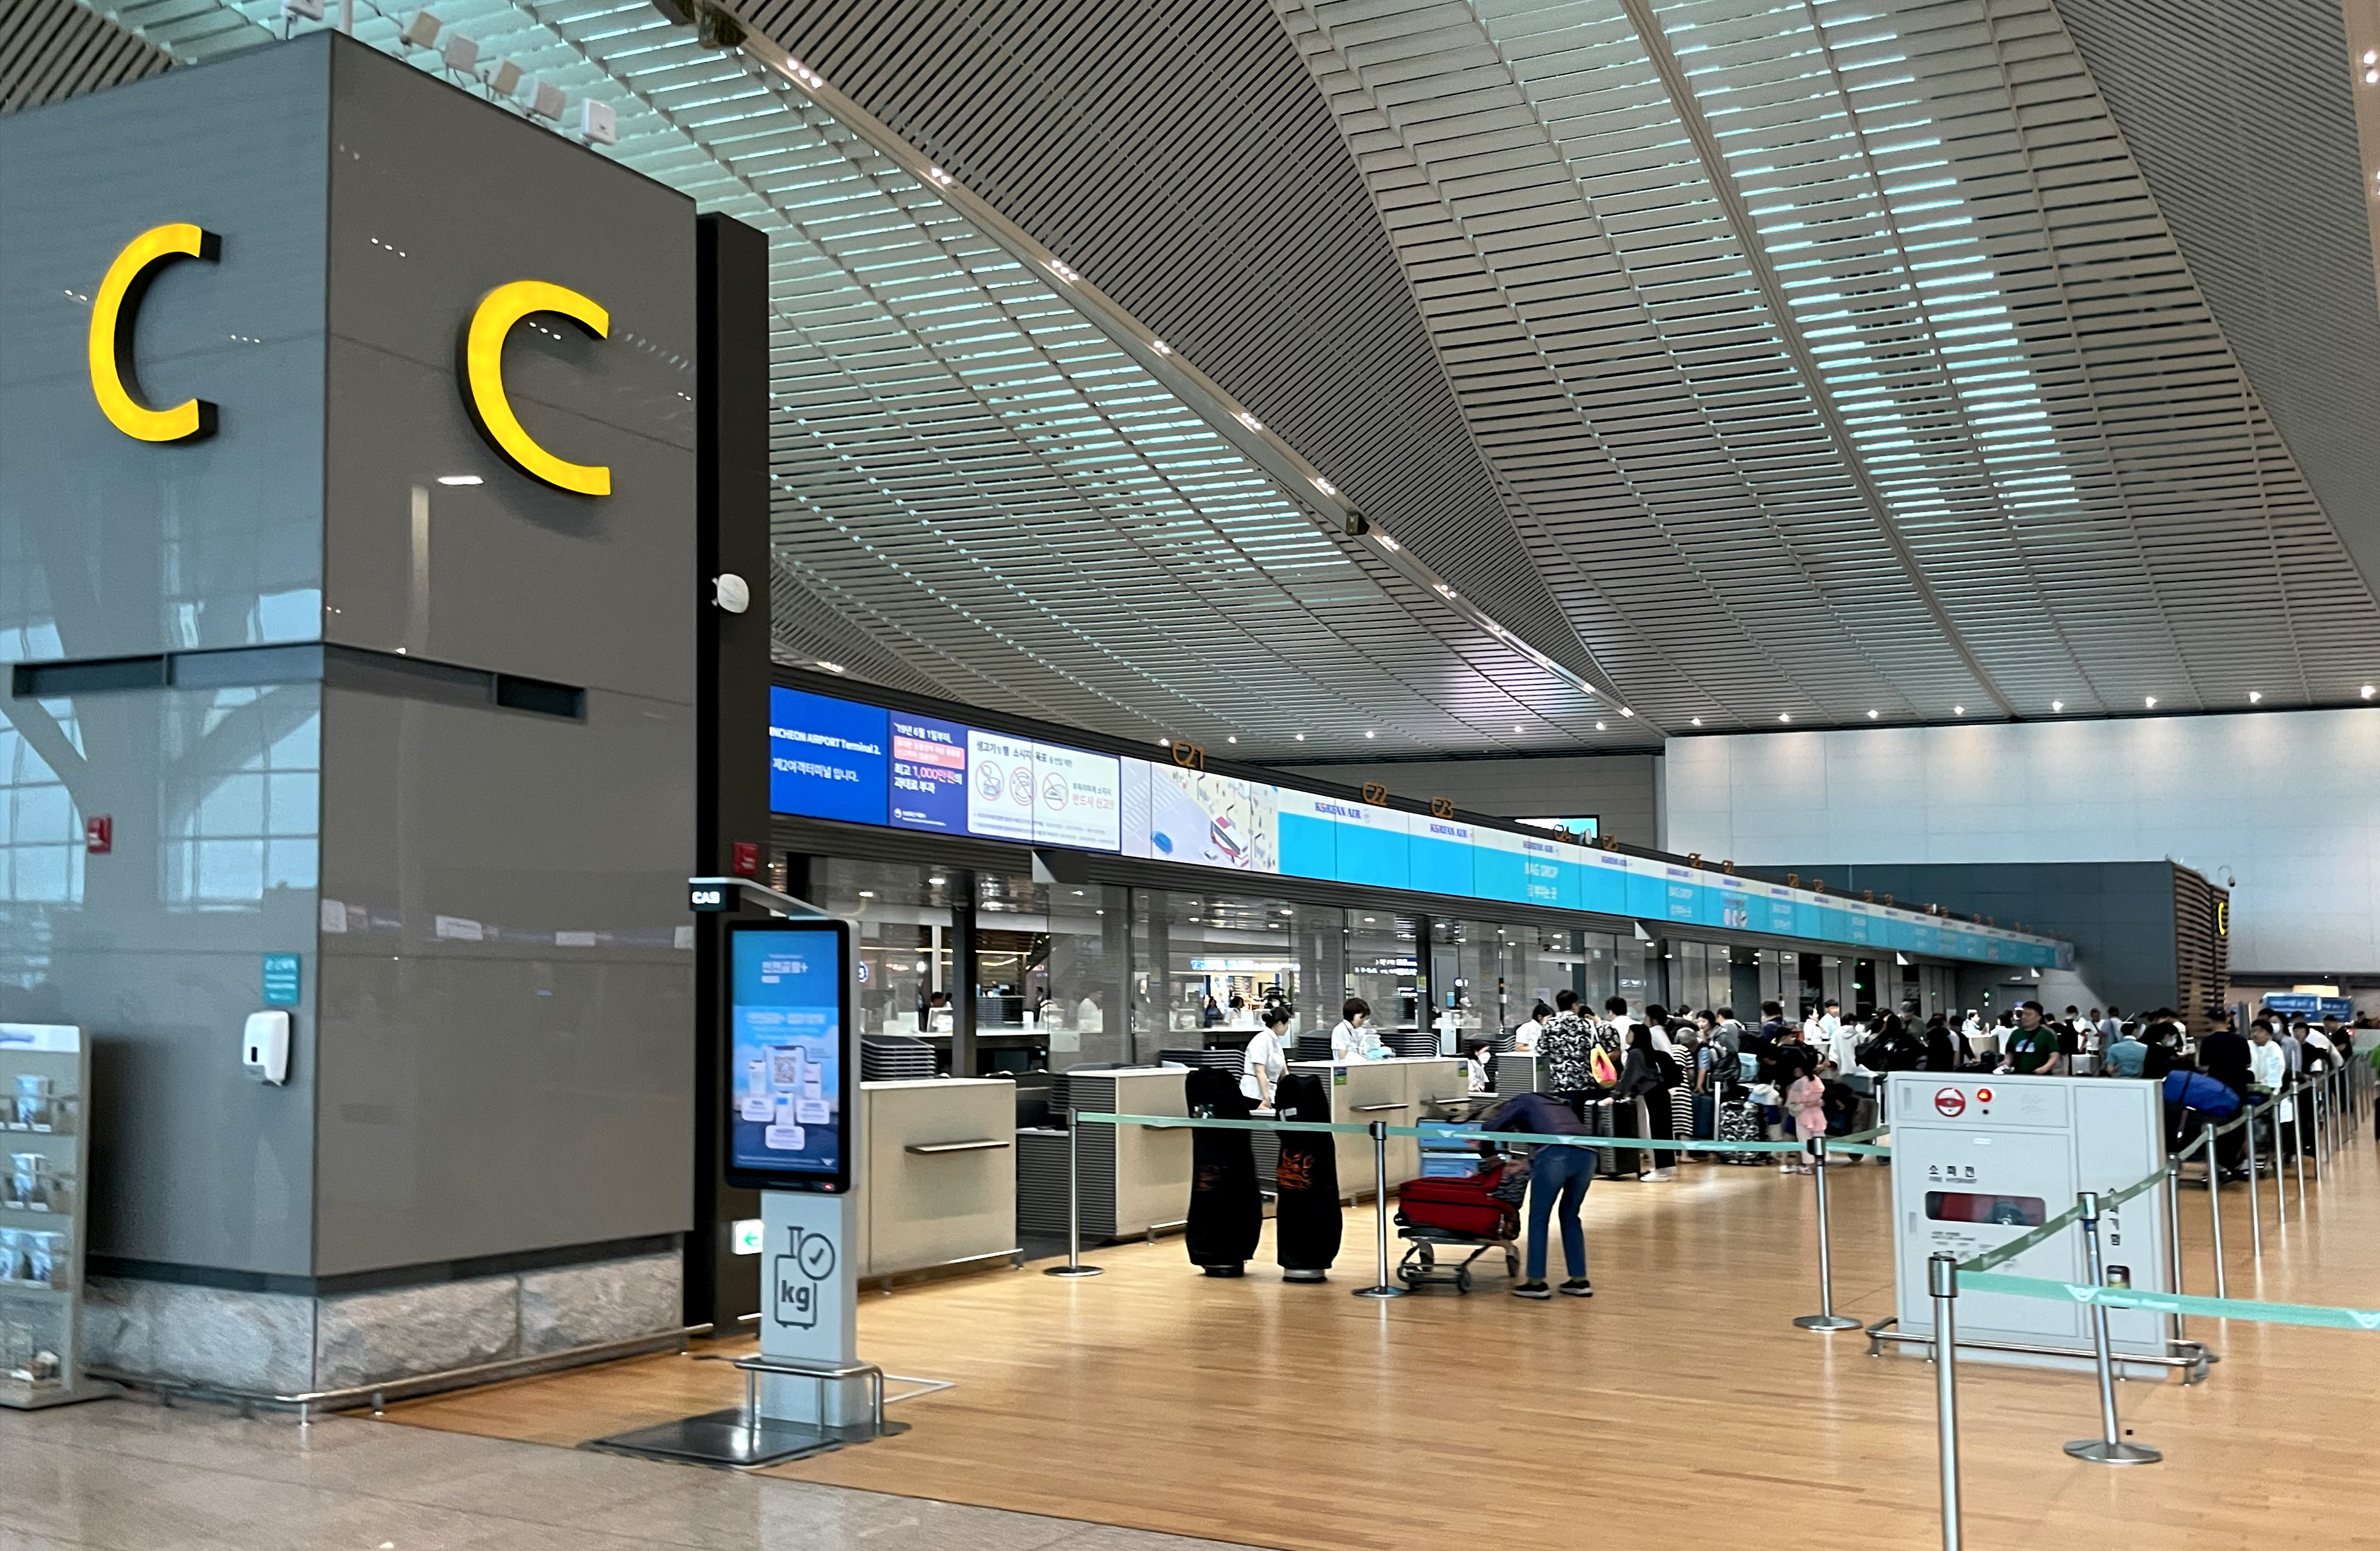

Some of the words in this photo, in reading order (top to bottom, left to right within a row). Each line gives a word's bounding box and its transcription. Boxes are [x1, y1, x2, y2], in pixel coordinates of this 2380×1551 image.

[90, 224, 213, 442] C
[463, 281, 611, 496] C
[1315, 802, 1345, 816] KOREAN
[1347, 809, 1361, 818] AIR
[1430, 824, 1454, 835] KOREAN
[1456, 830, 1467, 838] AIR
[692, 891, 720, 904] CAS
[781, 1280, 810, 1312] kg
